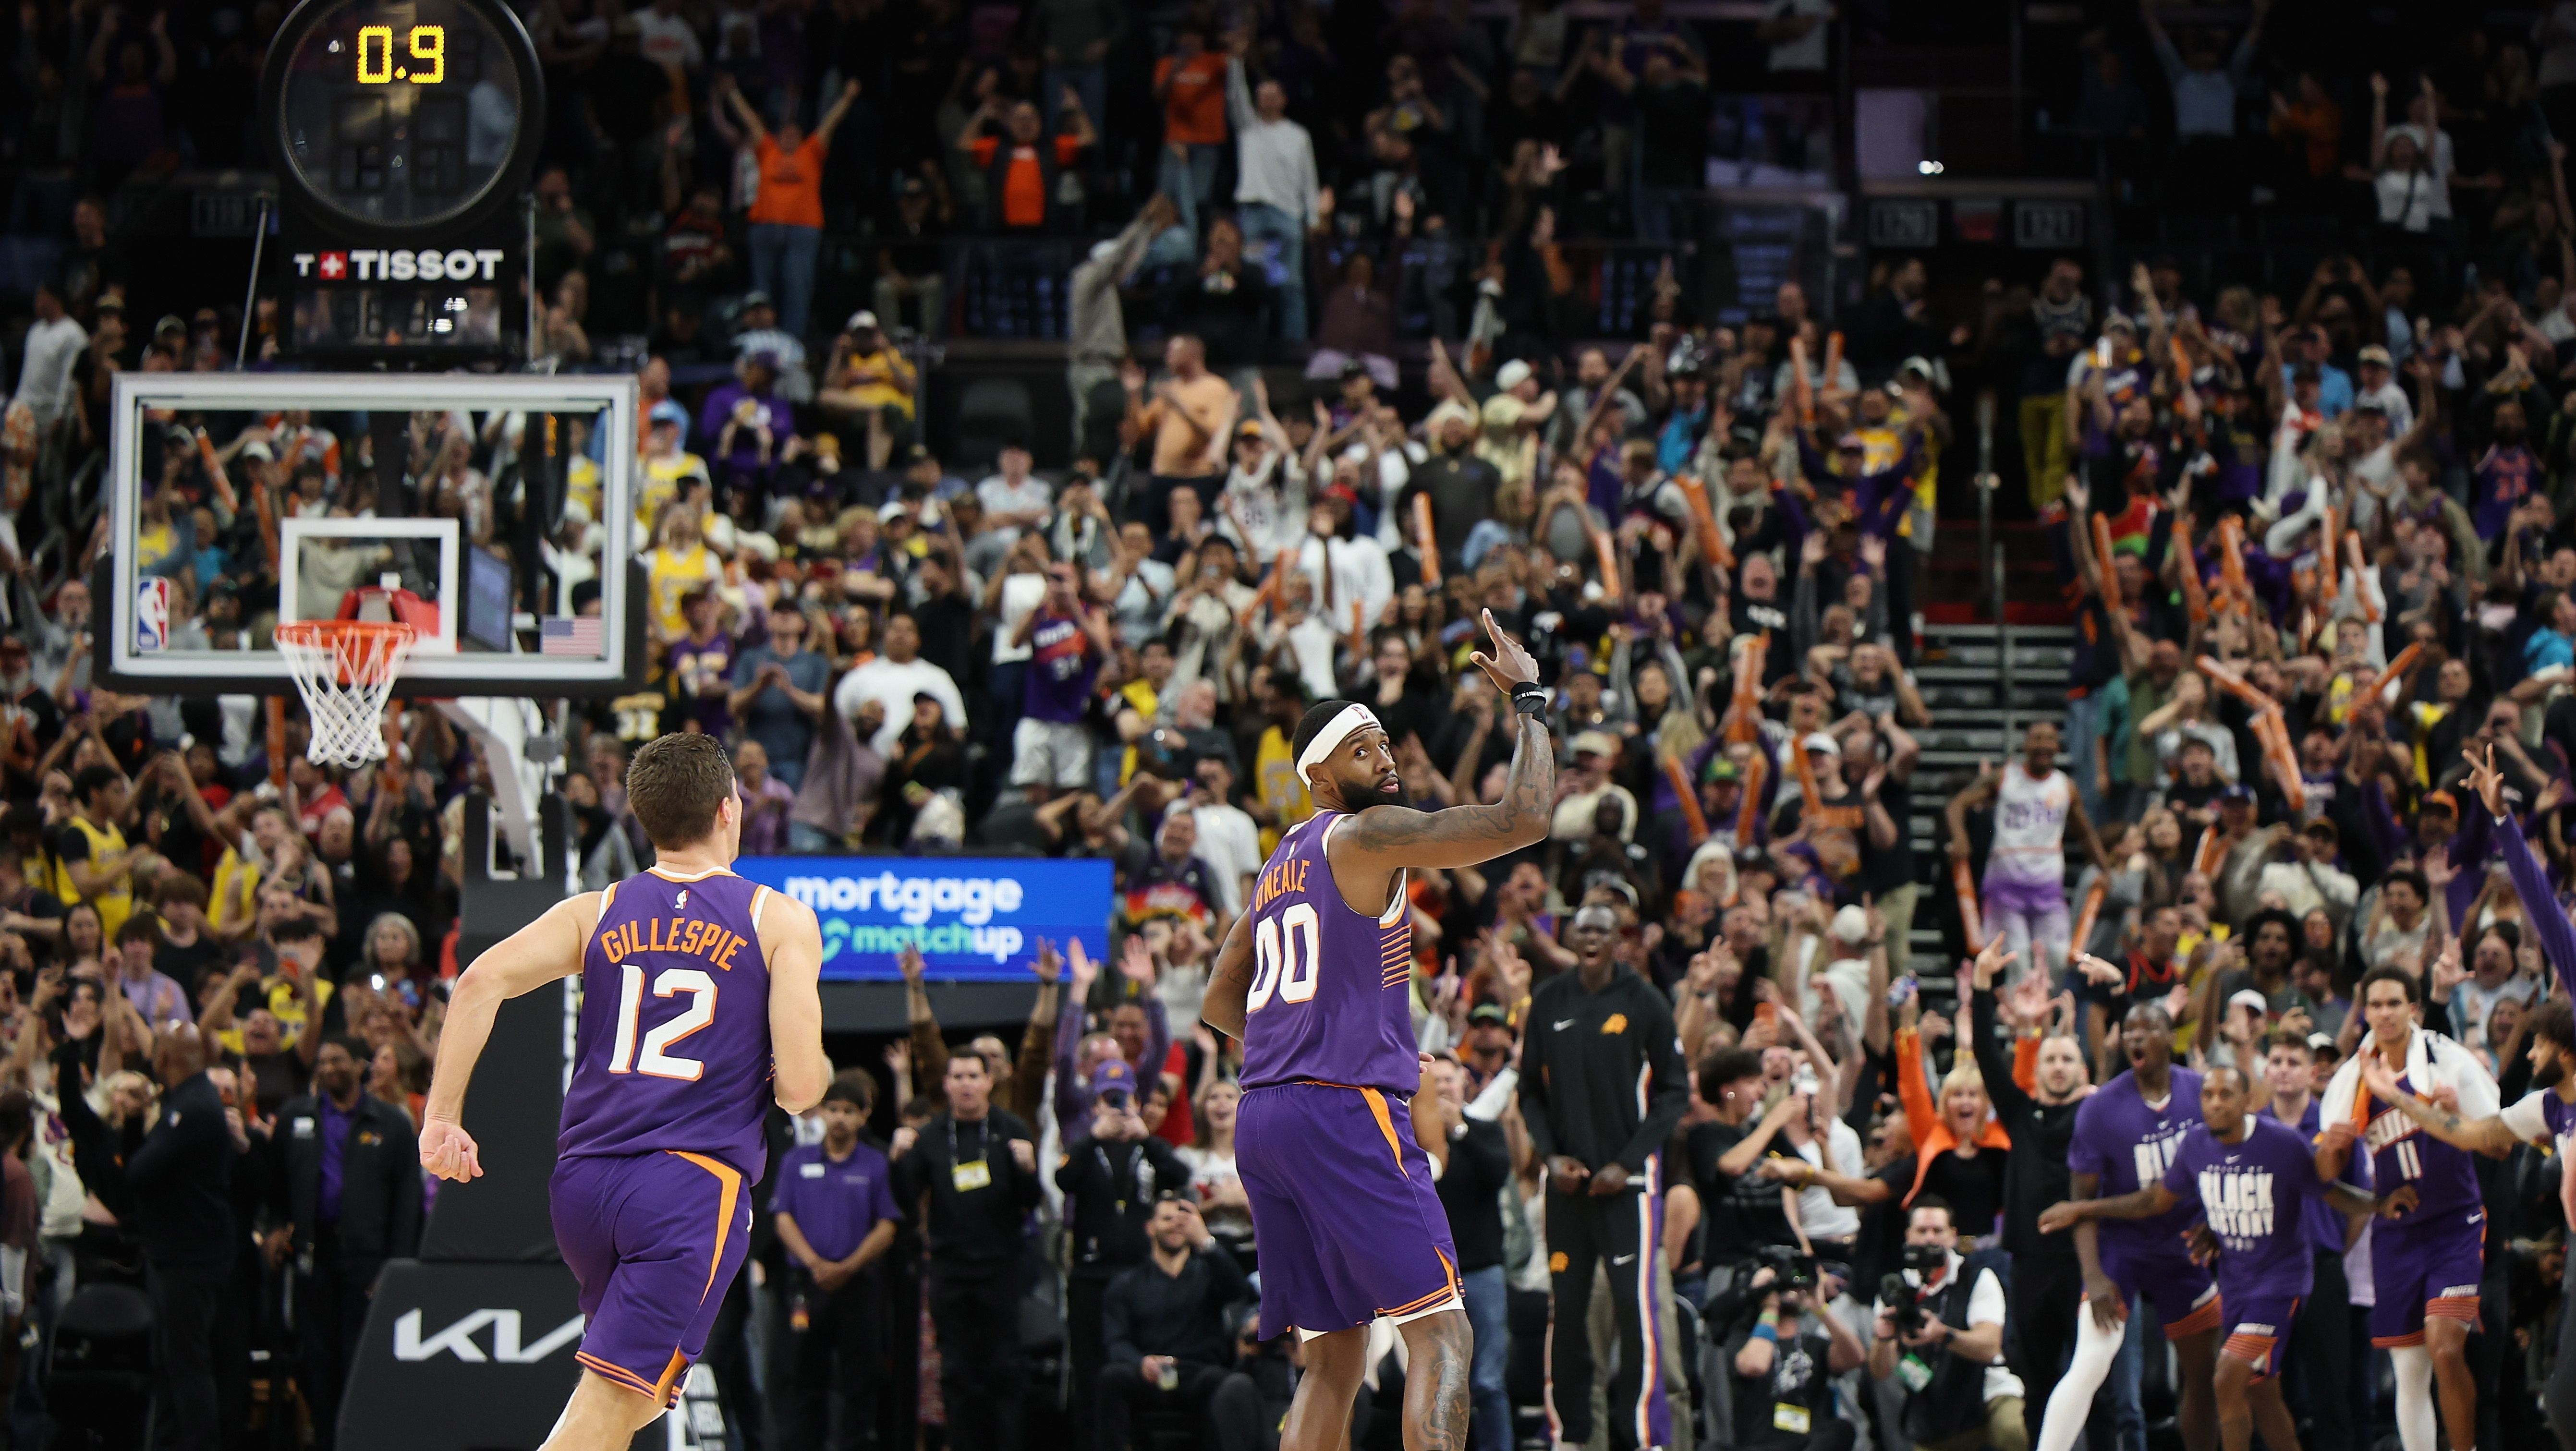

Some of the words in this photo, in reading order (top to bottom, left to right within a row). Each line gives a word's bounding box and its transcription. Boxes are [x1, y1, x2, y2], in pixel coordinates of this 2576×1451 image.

[357, 25, 444, 84] 0.9
[349, 249, 504, 280] TISSOT
[784, 870, 1024, 925] mortgage
[600, 918, 748, 971] GILLESPIE
[851, 920, 1024, 965] matchup
[1246, 902, 1319, 1014] 00
[608, 964, 718, 1081] 12
[2396, 1140, 2422, 1181] 11
[2199, 1171, 2274, 1210] BLACK
